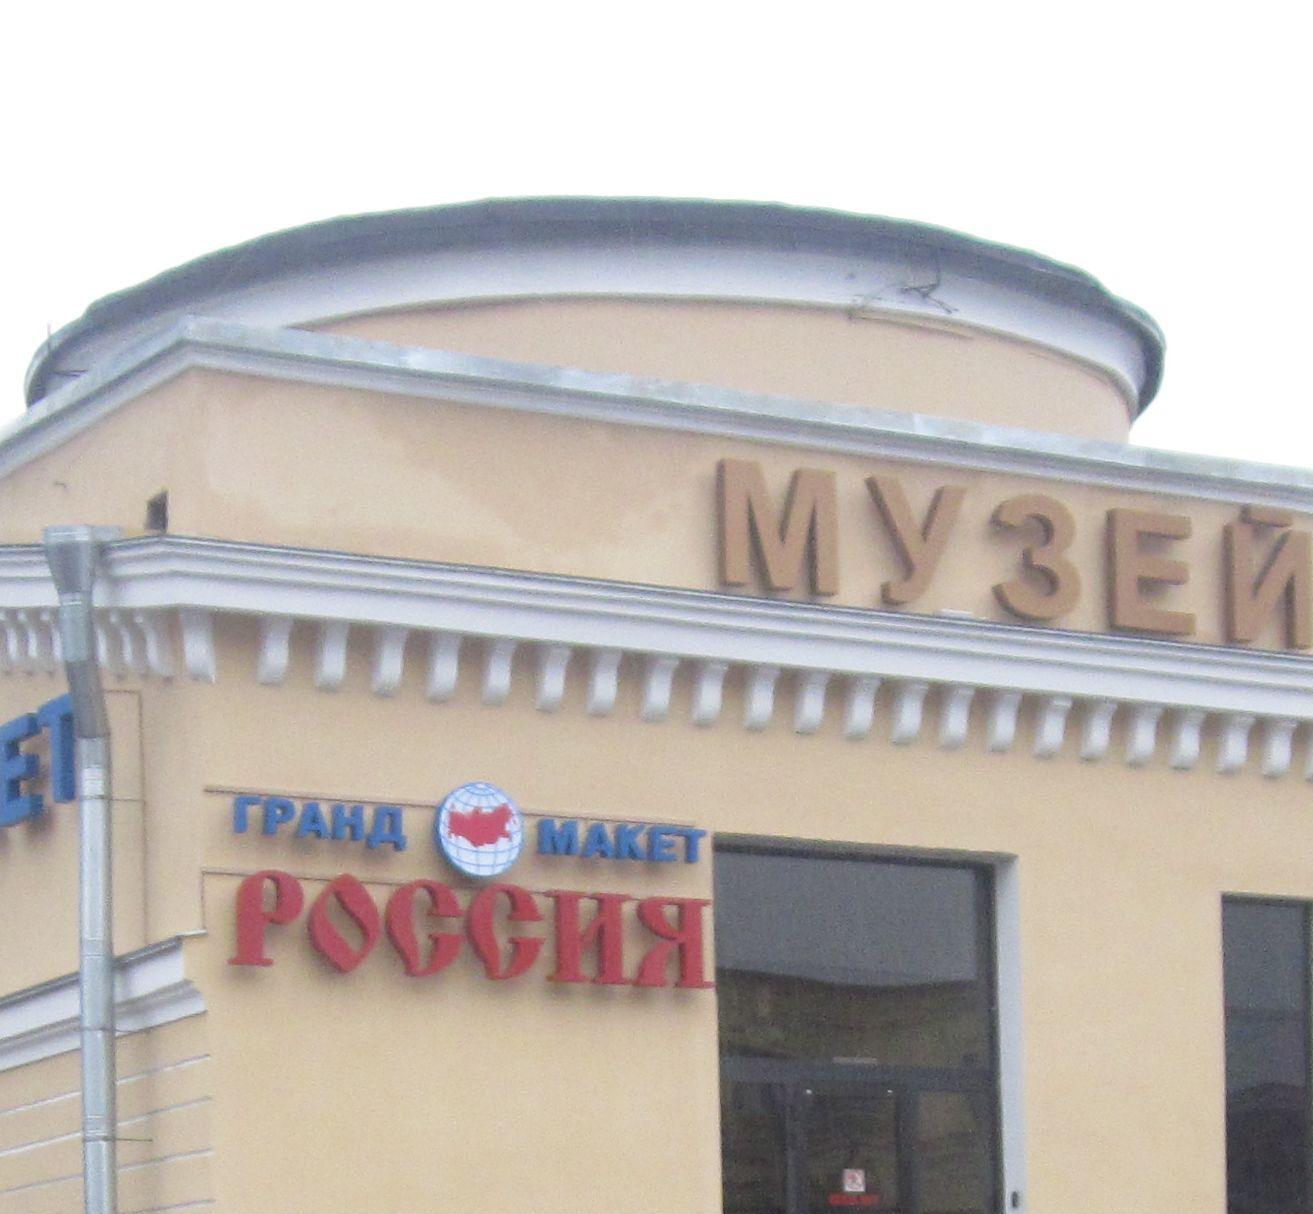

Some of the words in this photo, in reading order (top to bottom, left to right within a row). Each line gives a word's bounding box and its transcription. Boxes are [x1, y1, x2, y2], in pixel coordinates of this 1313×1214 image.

[232, 795, 408, 852] ГРАНД
[537, 817, 707, 865] МАКЕТ
[227, 868, 715, 989] РОССИЯ
